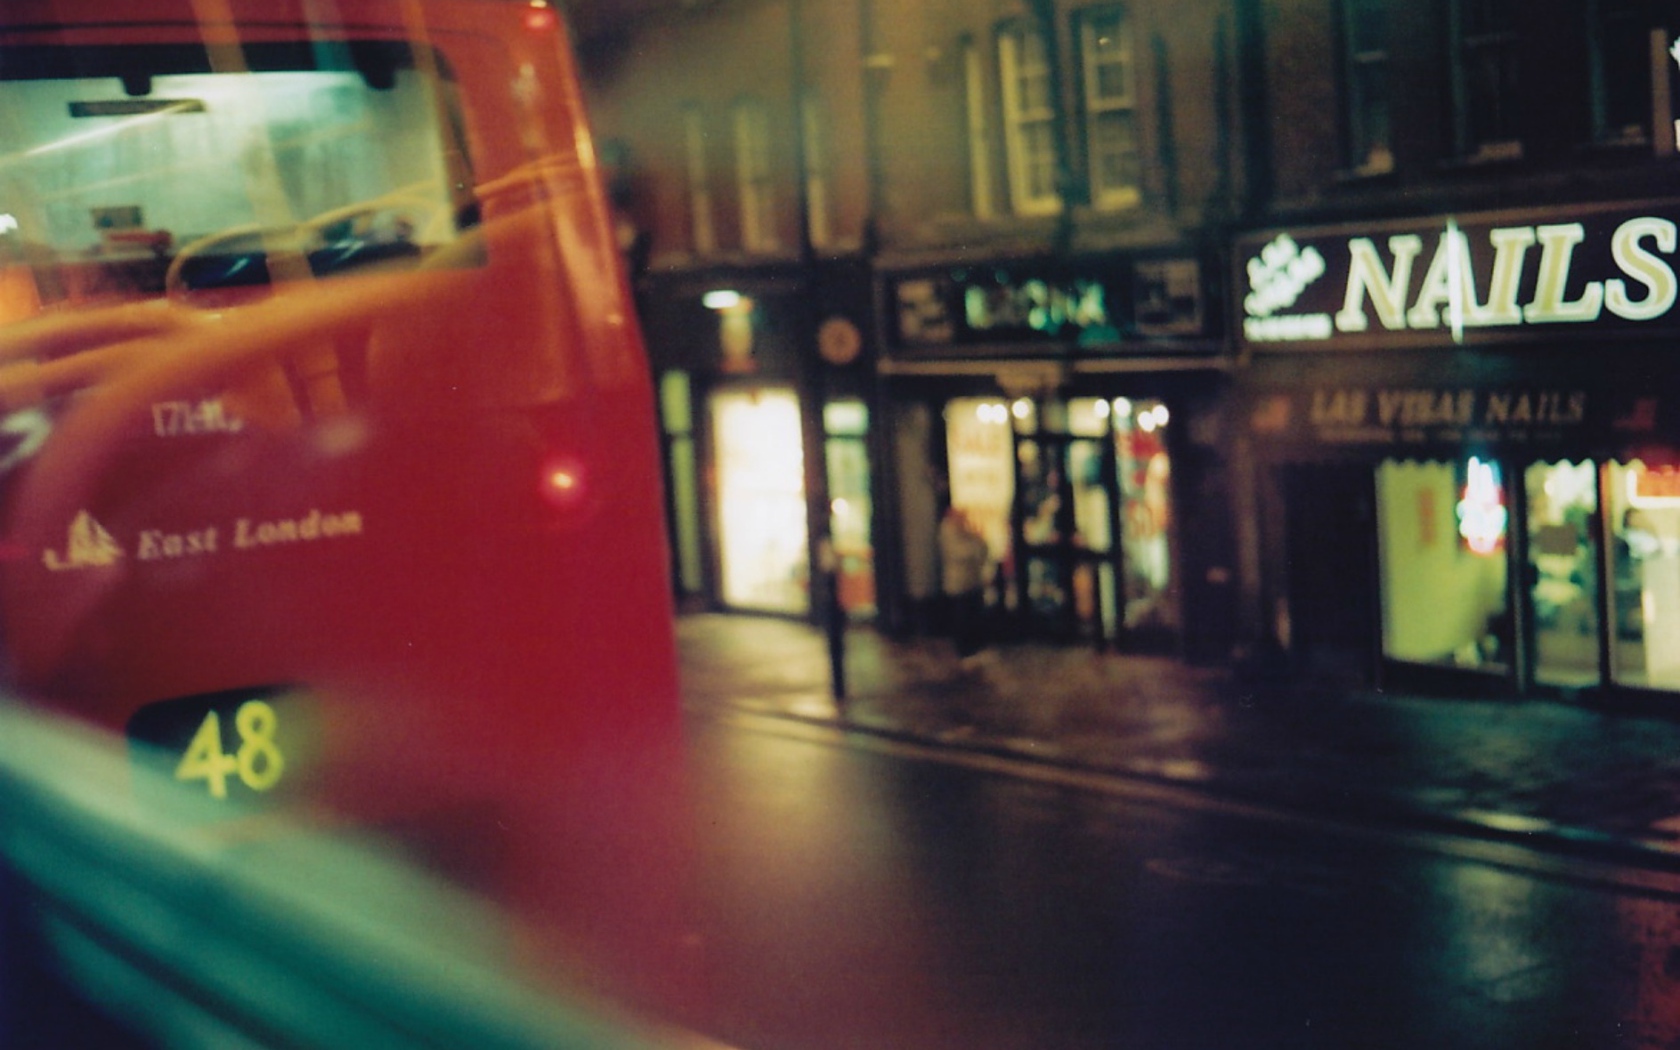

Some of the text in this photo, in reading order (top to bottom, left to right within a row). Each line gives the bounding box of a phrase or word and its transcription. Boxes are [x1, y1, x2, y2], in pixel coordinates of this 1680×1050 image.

[1335, 216, 1677, 332] NAILS
[1486, 391, 1585, 423] NAILS
[137, 509, 363, 560] East London
[174, 699, 283, 799] 48
